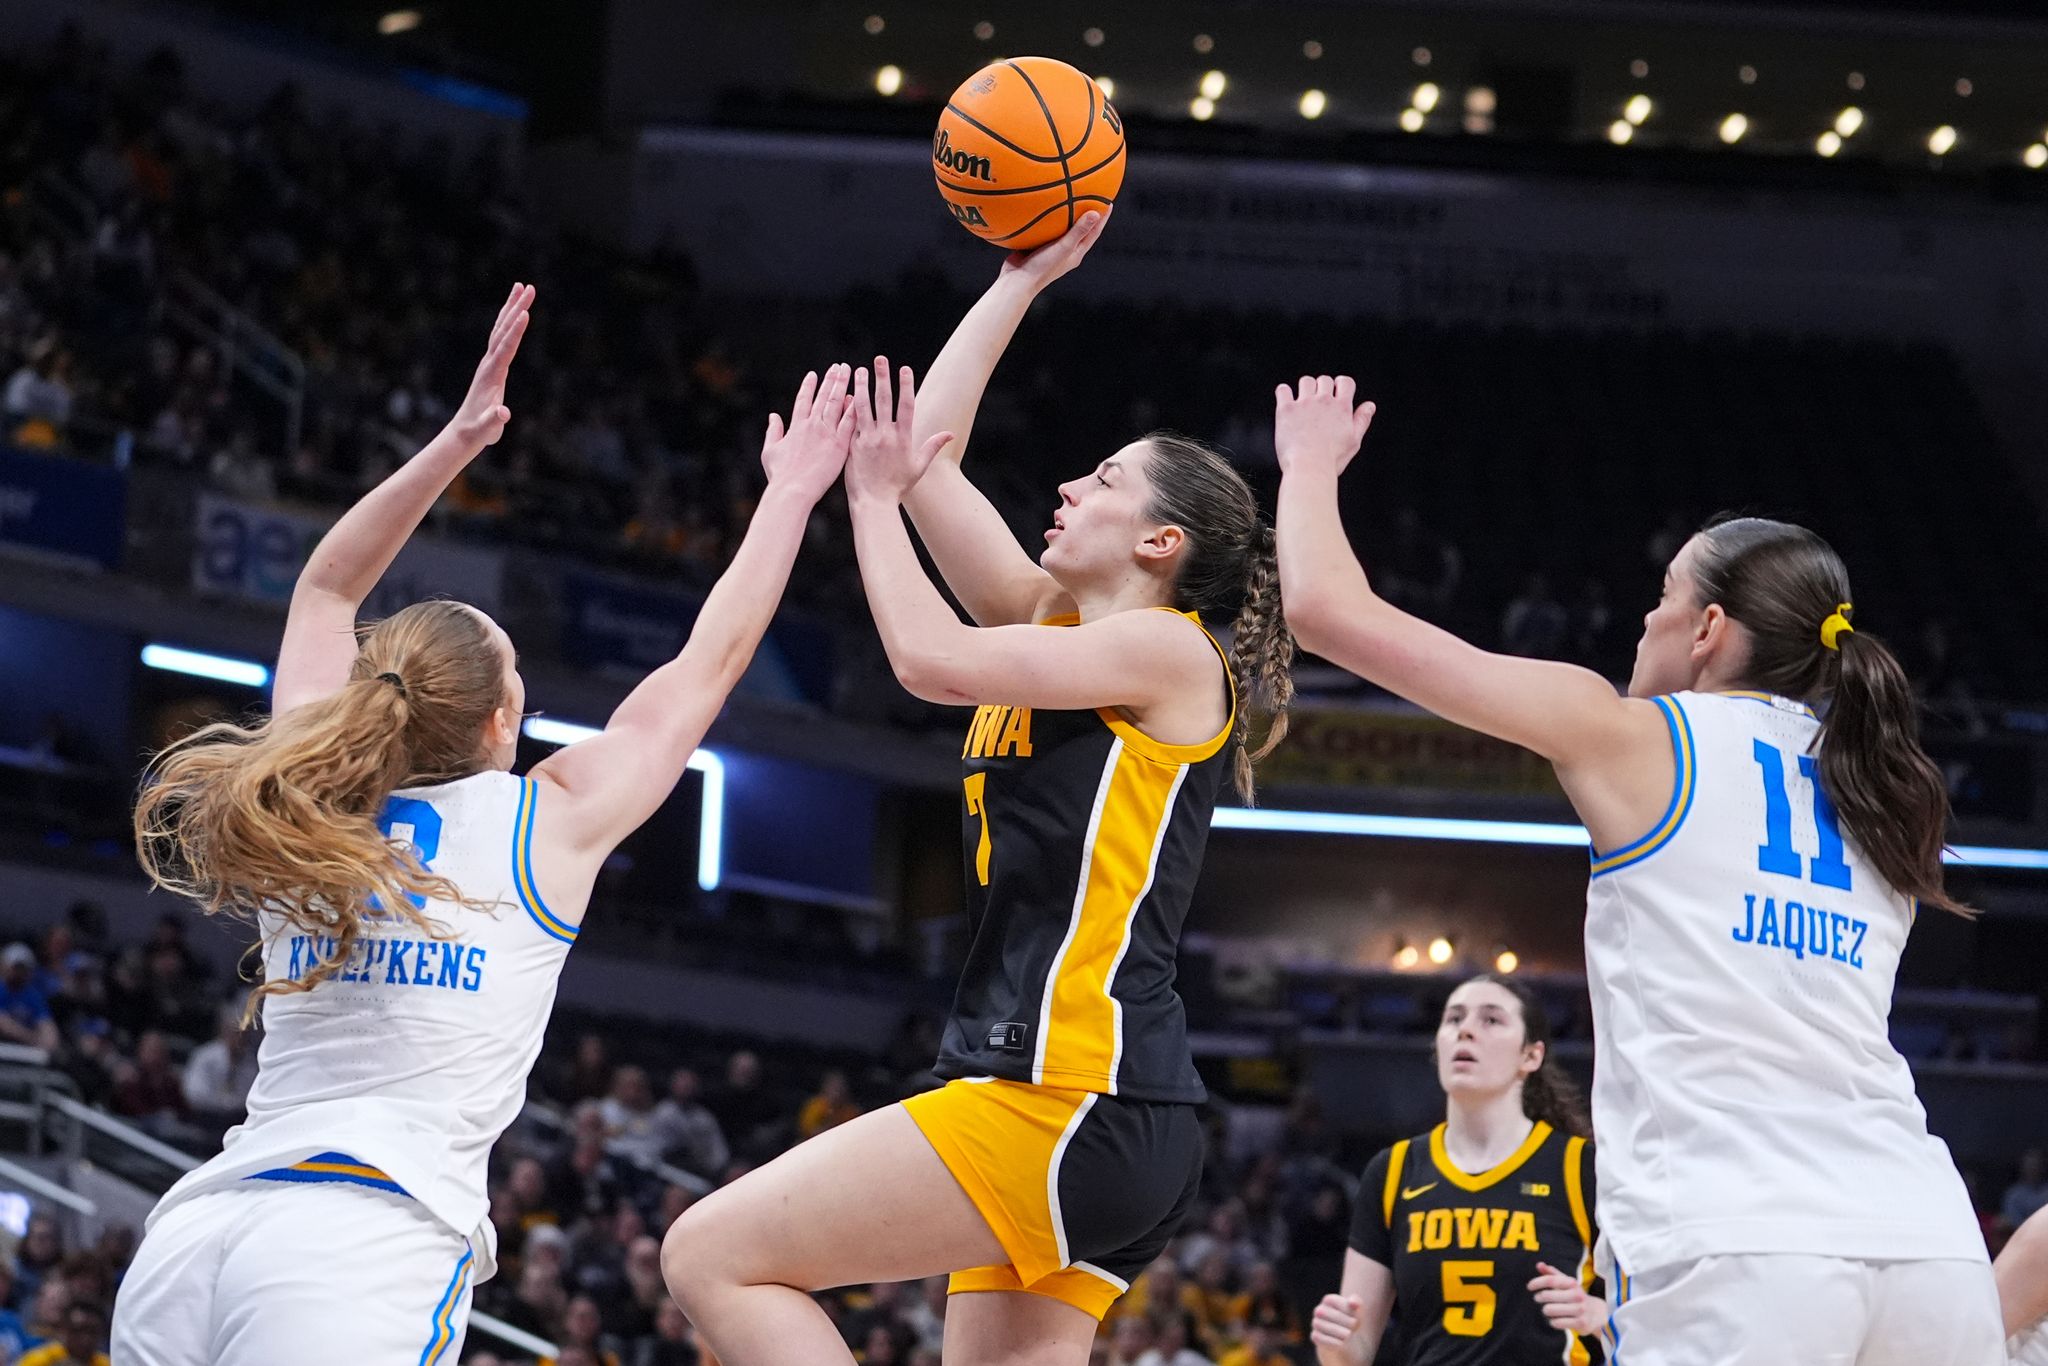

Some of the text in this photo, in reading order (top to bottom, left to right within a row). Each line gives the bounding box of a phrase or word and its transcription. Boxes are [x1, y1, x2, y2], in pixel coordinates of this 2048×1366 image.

[963, 772, 992, 886] 7
[1753, 737, 1852, 892] 11
[1732, 893, 1868, 969] JAQUEZ
[1407, 1208, 1540, 1253] IOWA
[1441, 1260, 1496, 1337] 5
